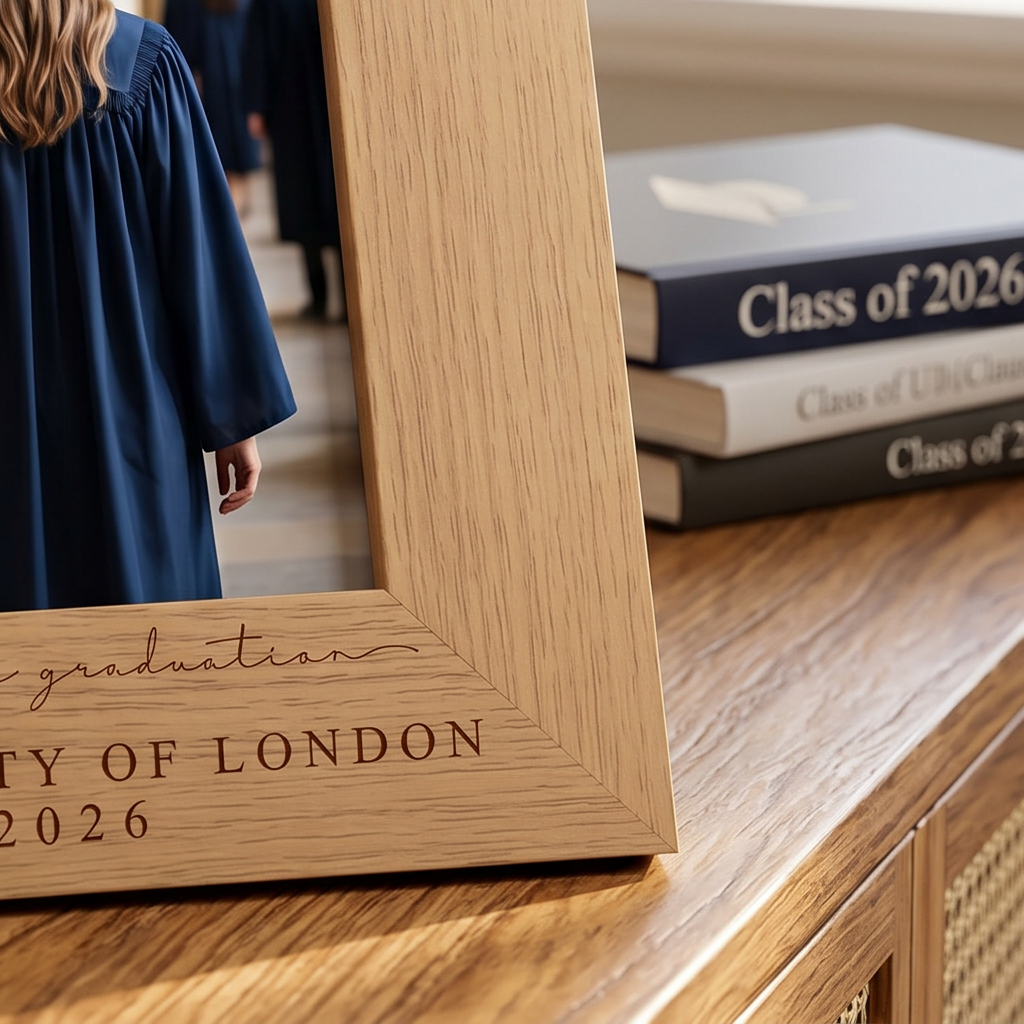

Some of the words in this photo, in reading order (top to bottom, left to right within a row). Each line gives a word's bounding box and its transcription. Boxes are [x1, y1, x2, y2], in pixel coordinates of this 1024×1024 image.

[737, 281, 857, 338] Class
[865, 262, 921, 323] of
[922, 252, 1024, 316] 2026
[885, 434, 969, 479] Class
[970, 420, 1011, 466] of
[29, 623, 420, 712] graduation
[101, 739, 179, 783] OF
[212, 718, 485, 776] LONDON
